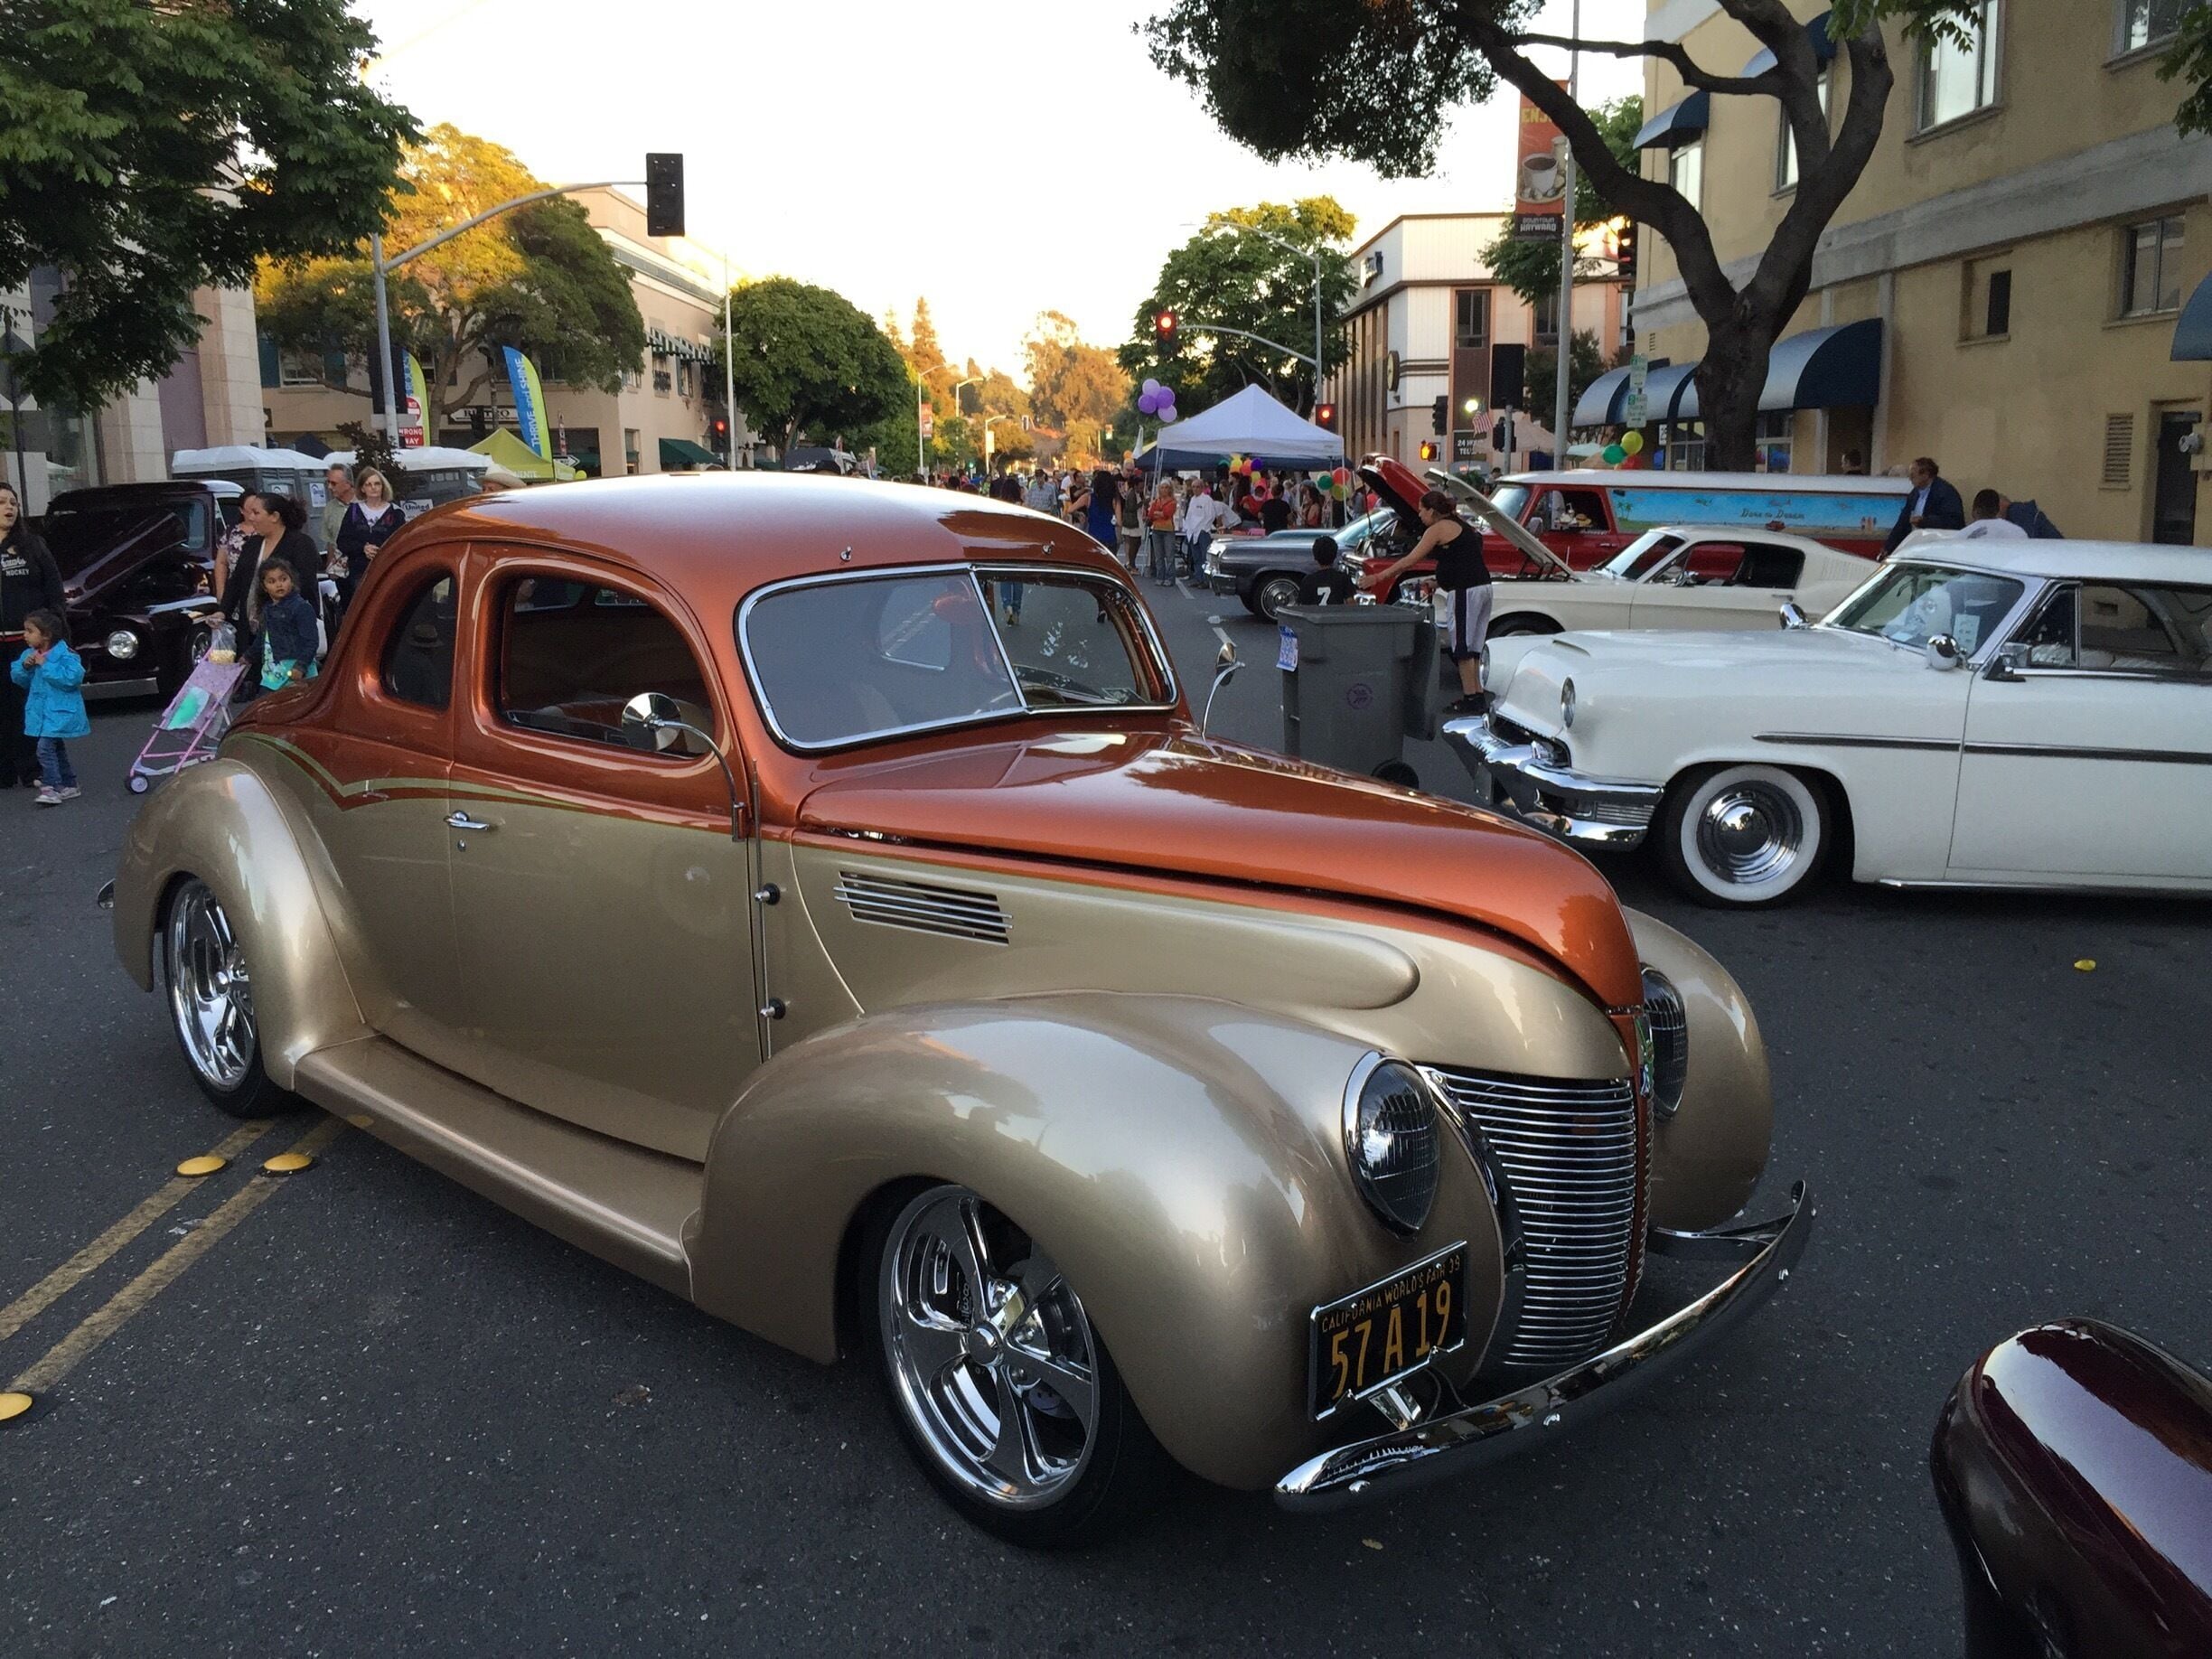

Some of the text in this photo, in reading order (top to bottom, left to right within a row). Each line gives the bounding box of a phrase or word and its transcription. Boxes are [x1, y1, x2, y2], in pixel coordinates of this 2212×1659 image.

[1523, 108, 1551, 123] ENJ
[1520, 223, 1557, 231] HAYWARD
[515, 358, 541, 447] THRIVE and SHINE
[398, 427, 423, 436] WRONG
[5, 568, 30, 576] HOCKEY
[1317, 586, 1332, 606] 7
[1321, 1298, 1382, 1333] CALIFORNIA
[1384, 1273, 1425, 1306] WORLD'S
[1331, 1279, 1451, 1401] 57 A 19
